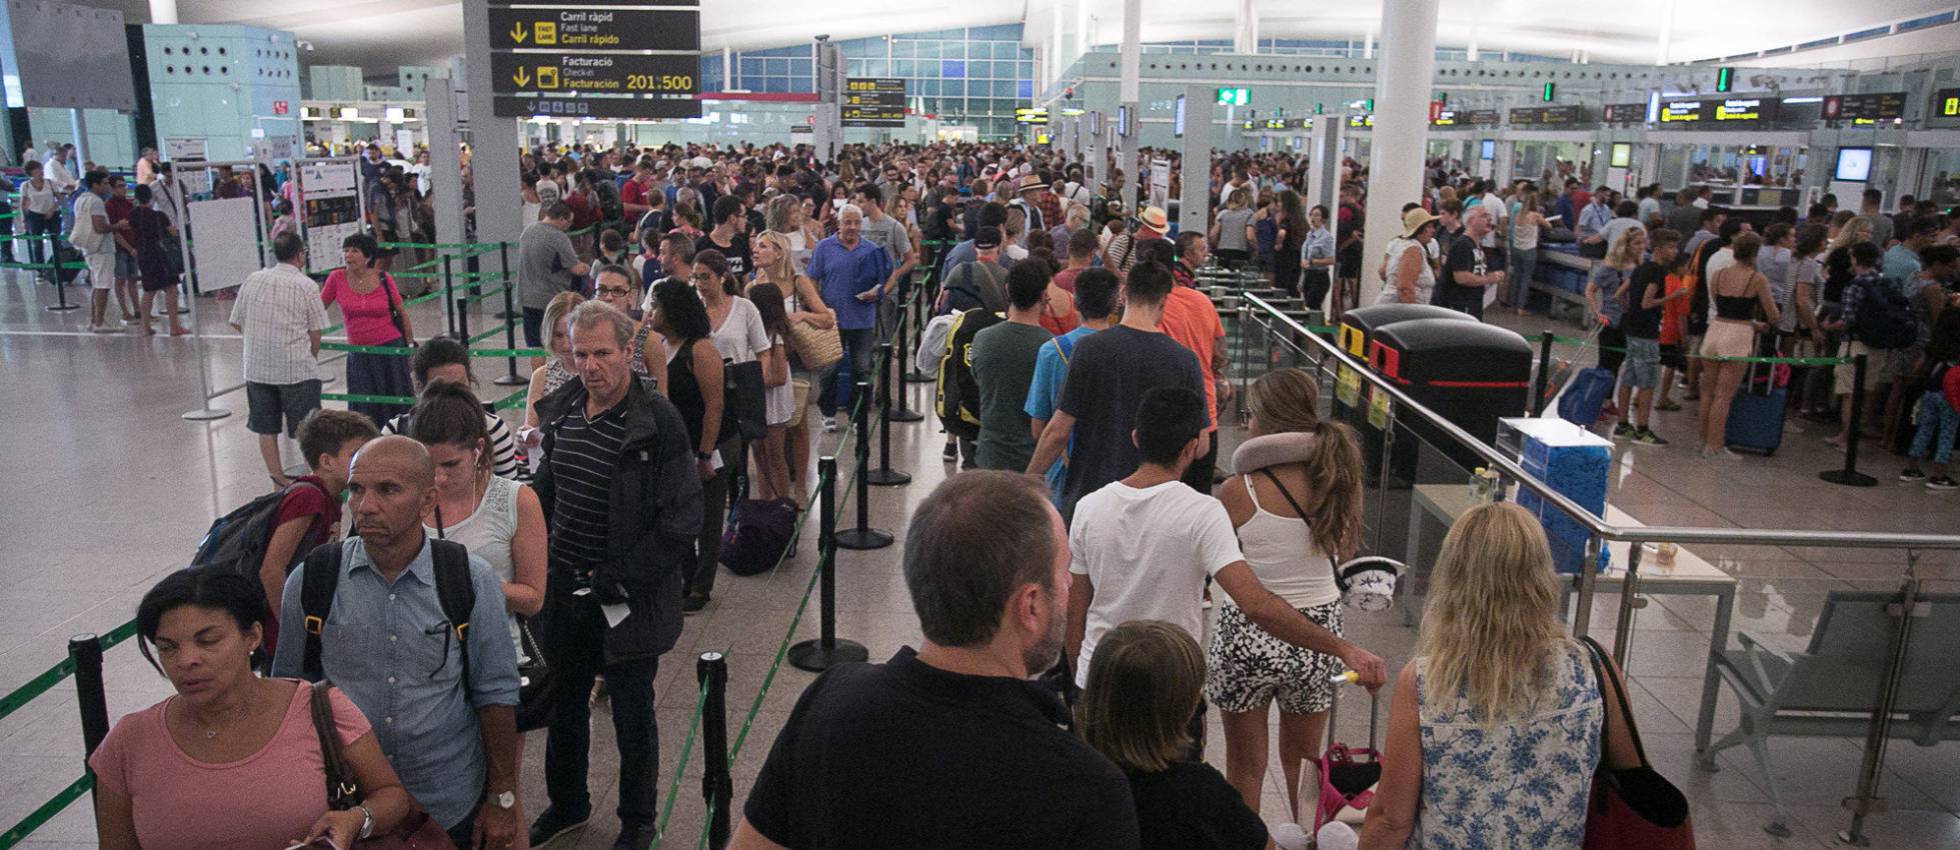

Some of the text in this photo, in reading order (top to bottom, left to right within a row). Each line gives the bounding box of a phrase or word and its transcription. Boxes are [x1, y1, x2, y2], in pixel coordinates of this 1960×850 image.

[560, 11, 613, 23] Carril ràpid
[560, 23, 598, 32] Fast lane
[561, 34, 587, 44] Carril
[562, 56, 613, 67] Facturació
